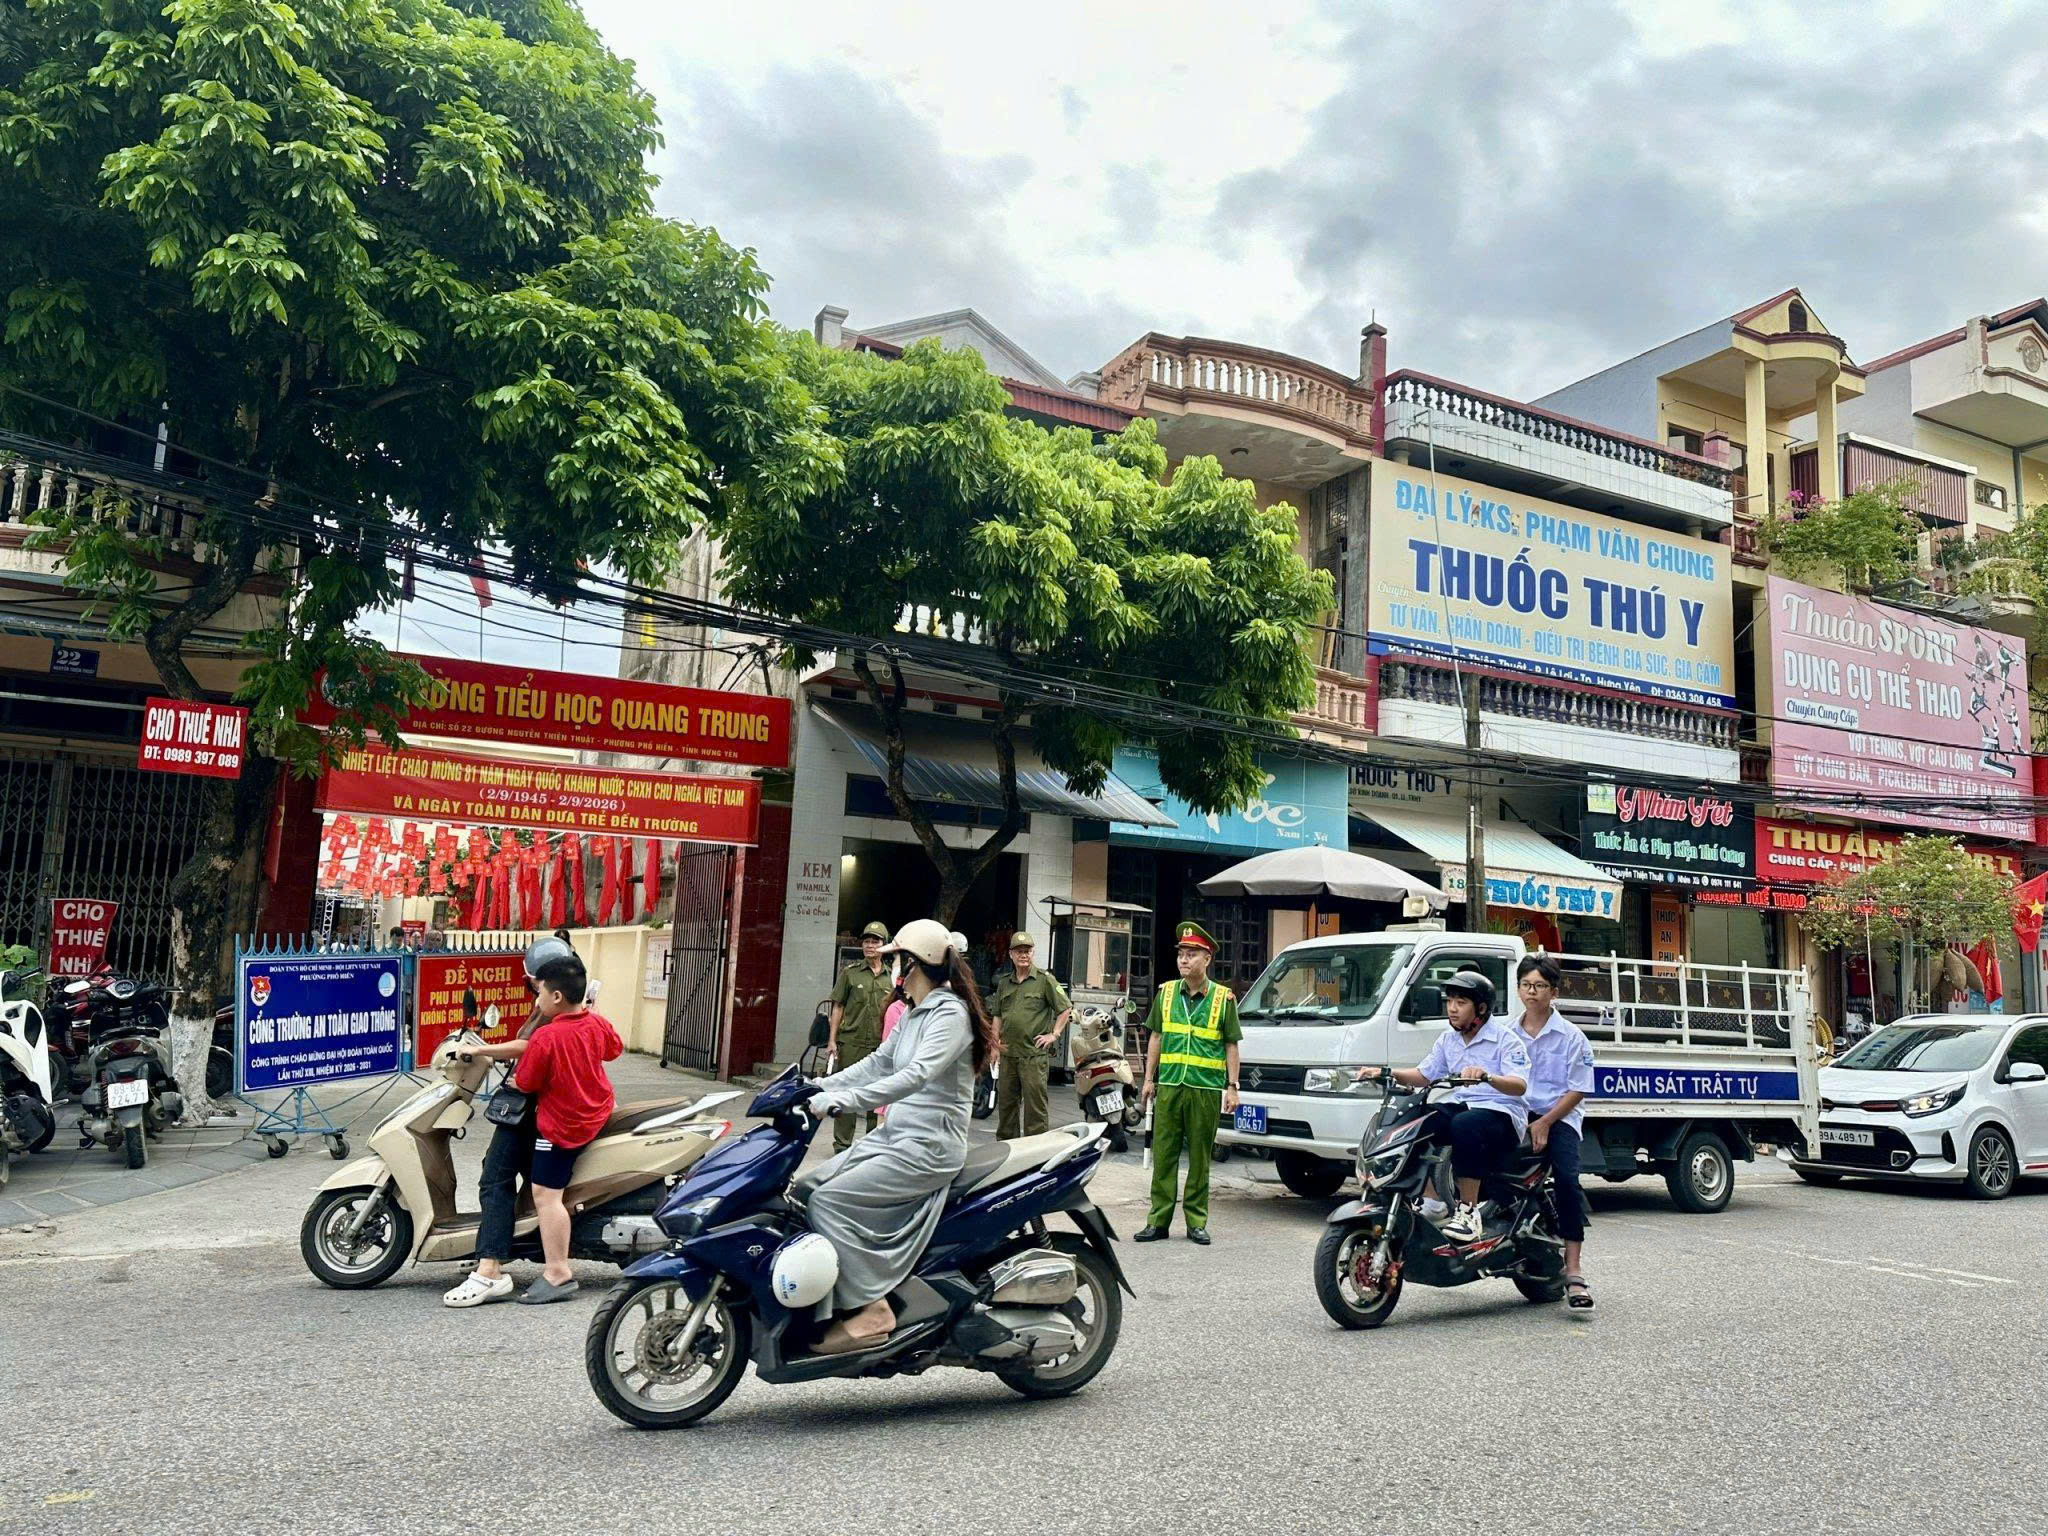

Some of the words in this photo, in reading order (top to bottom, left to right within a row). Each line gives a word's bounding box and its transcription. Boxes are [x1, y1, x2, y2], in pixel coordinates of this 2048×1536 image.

[1395, 479, 1436, 521] ĐẠI
[1526, 511, 1591, 553] PHẠM
[1598, 528, 1640, 564] VĂN
[1647, 541, 1714, 581] CHUNG
[1408, 539, 1568, 619] THUỐC
[1584, 577, 1666, 640] THÚ
[1680, 599, 1704, 646] Y
[1390, 603, 1407, 627] TƯ
[1486, 621, 1522, 649] ĐOÁN
[1624, 648, 1642, 672] GIA
[1675, 659, 1693, 680] GIA
[1878, 618, 1957, 667] SPORT
[56, 650, 81, 666] 22
[1783, 649, 1841, 698] DỤNG
[1846, 661, 1873, 710] CỤ
[1876, 662, 1912, 710] THỂ
[1915, 678, 1962, 720] THAO
[404, 668, 486, 713] ƯỜNG
[495, 672, 547, 719] TIỂU
[555, 692, 602, 730] HỌC
[611, 698, 689, 734] QUANG
[698, 708, 769, 742] TRUNG
[1787, 699, 1817, 718] Chuyên
[1817, 706, 1839, 723] Cung
[146, 707, 175, 741] CHO
[178, 707, 212, 745] THUÊ
[212, 710, 241, 748] NHÀ
[144, 745, 161, 760] ĐT:
[163, 747, 192, 763] 0989
[194, 750, 215, 765] 397
[217, 753, 239, 768] 089
[1849, 734, 1866, 756] VỢT
[1909, 744, 1926, 766] VỢT
[342, 750, 374, 776] NHIỆT
[376, 752, 398, 778] LIỆT
[400, 756, 428, 779] CHÀO
[430, 758, 462, 782] MỪNG
[465, 766, 476, 783] 81
[480, 763, 504, 785] NĂM
[506, 766, 533, 790] NGÀY
[535, 767, 562, 791] QUỐC
[564, 772, 597, 794] KHÁNH
[599, 775, 625, 797] NƯỚC
[627, 779, 651, 800] CHXH
[654, 777, 673, 801] CHỦ
[675, 782, 701, 803] NGHĨA
[704, 784, 723, 808] VIỆT
[724, 789, 745, 806] NAM
[1794, 754, 1813, 778] VỢT
[1816, 756, 1846, 779] BÓNG
[394, 794, 413, 809] VÀ
[418, 797, 461, 815] NGÀY
[466, 800, 505, 818] TOÀN
[510, 804, 541, 821] DÂN
[546, 808, 575, 824] ĐƯA
[581, 808, 606, 826] TRẺ
[611, 812, 639, 829] ĐẾN
[644, 816, 698, 833] TRƯỜNG
[1688, 796, 1733, 827] Pet
[1276, 827, 1300, 839] Nam
[1640, 838, 1649, 853] &
[1651, 839, 1671, 859] Phụ
[1674, 840, 1698, 861] Kiện
[1700, 843, 1718, 861] Thú
[1720, 847, 1745, 867] Cung
[1768, 853, 1805, 867] CUNG
[803, 863, 832, 878] KEM
[797, 882, 830, 892] VINAMILK
[1449, 878, 1465, 889] 18
[1555, 885, 1596, 912] THÚ
[1601, 892, 1613, 915] Y
[62, 902, 104, 921] CHO
[55, 928, 106, 947] THUÊ
[445, 960, 467, 985] ĐỀ
[505, 986, 525, 999] SINH
[250, 1010, 275, 1044] CỔNG
[276, 1011, 312, 1042] TRƯỜNG
[313, 1015, 326, 1038] AN
[328, 1009, 349, 1036] TOÀN
[351, 1011, 369, 1035] GIAO
[371, 1005, 396, 1032] THÔNG
[420, 1007, 446, 1026] KHÔNG
[448, 1009, 463, 1023] CHO
[251, 1055, 270, 1068] CÔNG
[270, 1054, 290, 1066] TRÌNH
[290, 1052, 308, 1064] CHÀO
[308, 1050, 326, 1062] MỪNG
[363, 1044, 378, 1055] TOÀN
[1603, 1069, 1650, 1094] CẢNH
[1655, 1071, 1686, 1094] SÁT
[1691, 1073, 1733, 1098] TRẬT
[1738, 1076, 1758, 1099] TỰ
[1237, 1117, 1262, 1130] 004.67
[1243, 1106, 1257, 1118] 89A
[644, 1136, 684, 1146] LEAD
